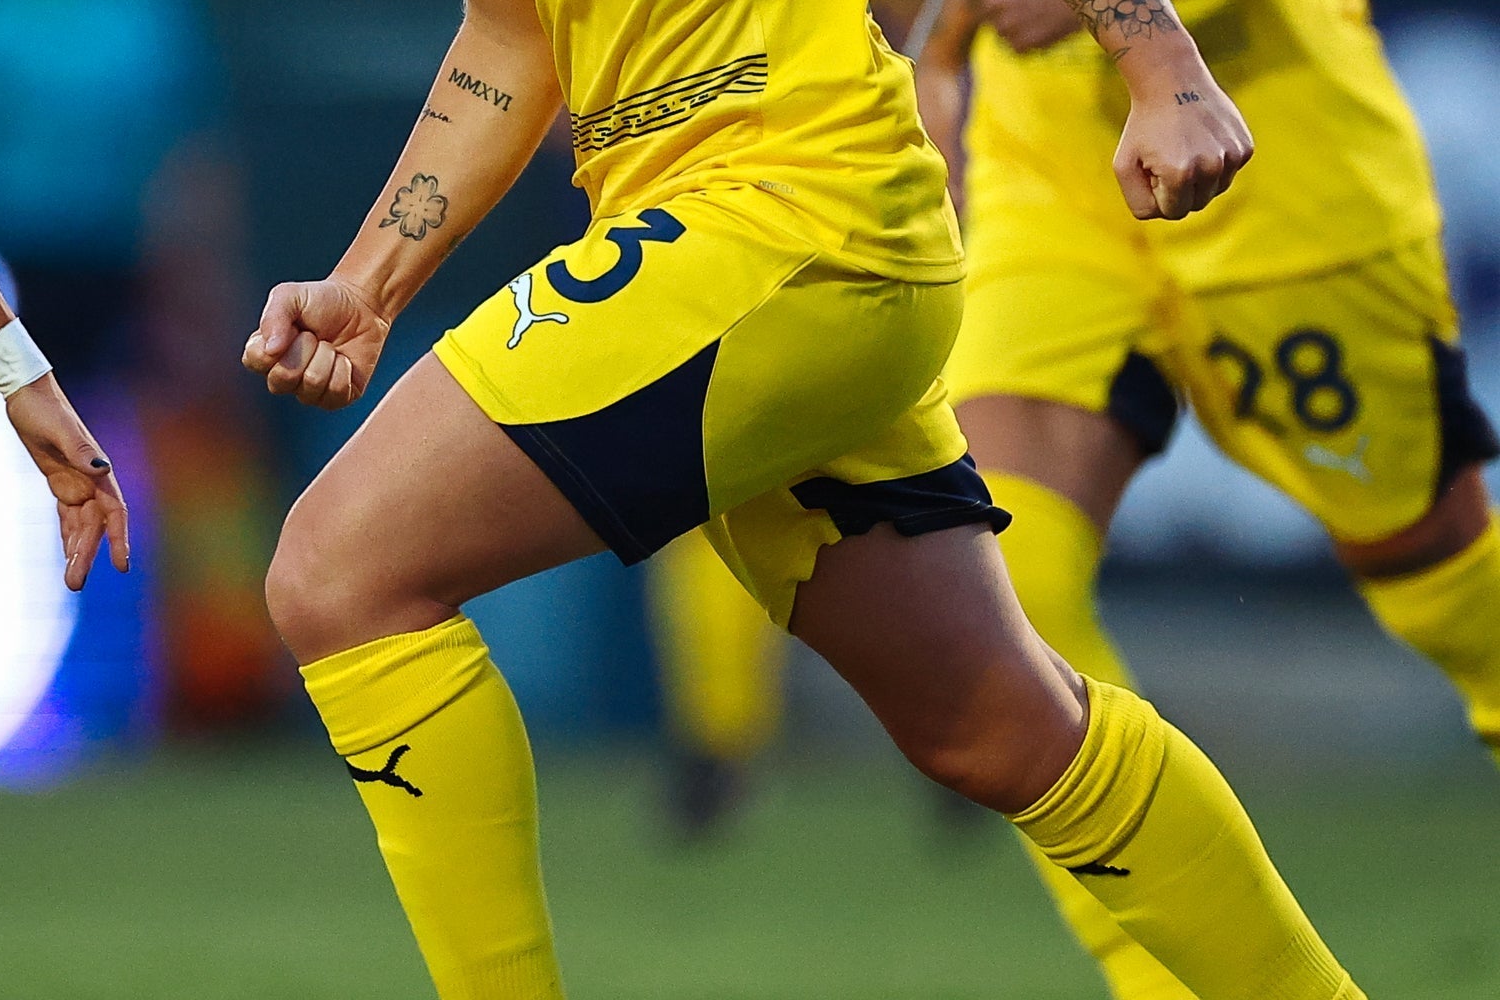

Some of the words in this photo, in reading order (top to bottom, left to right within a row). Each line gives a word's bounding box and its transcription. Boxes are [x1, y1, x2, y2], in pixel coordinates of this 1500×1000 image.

[448, 68, 513, 111] MMXVI
[546, 208, 687, 304] 3
[1208, 328, 1359, 436] 28
